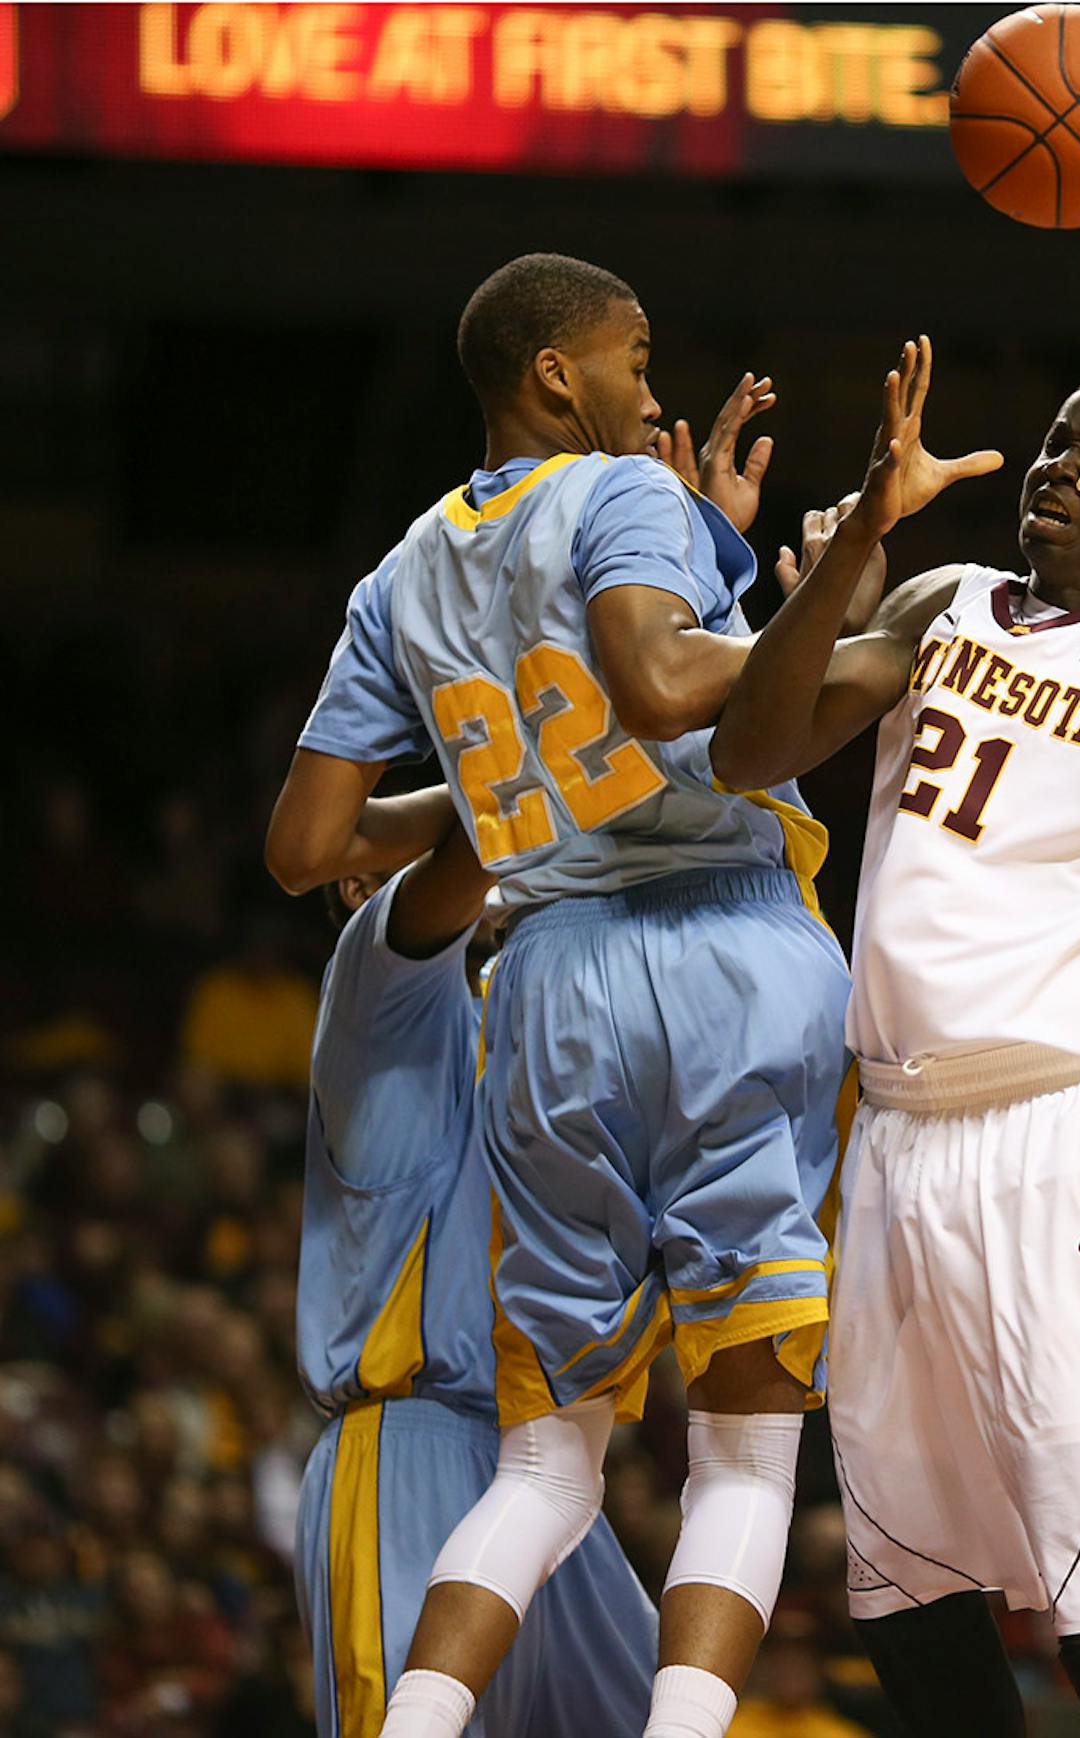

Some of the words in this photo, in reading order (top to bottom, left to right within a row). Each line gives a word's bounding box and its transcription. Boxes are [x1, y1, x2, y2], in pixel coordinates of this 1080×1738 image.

[139, 4, 364, 100] LOVE
[367, 8, 490, 106] AT
[492, 12, 743, 118] FIRST
[432, 639, 669, 868] 22
[897, 706, 1016, 845] 21
